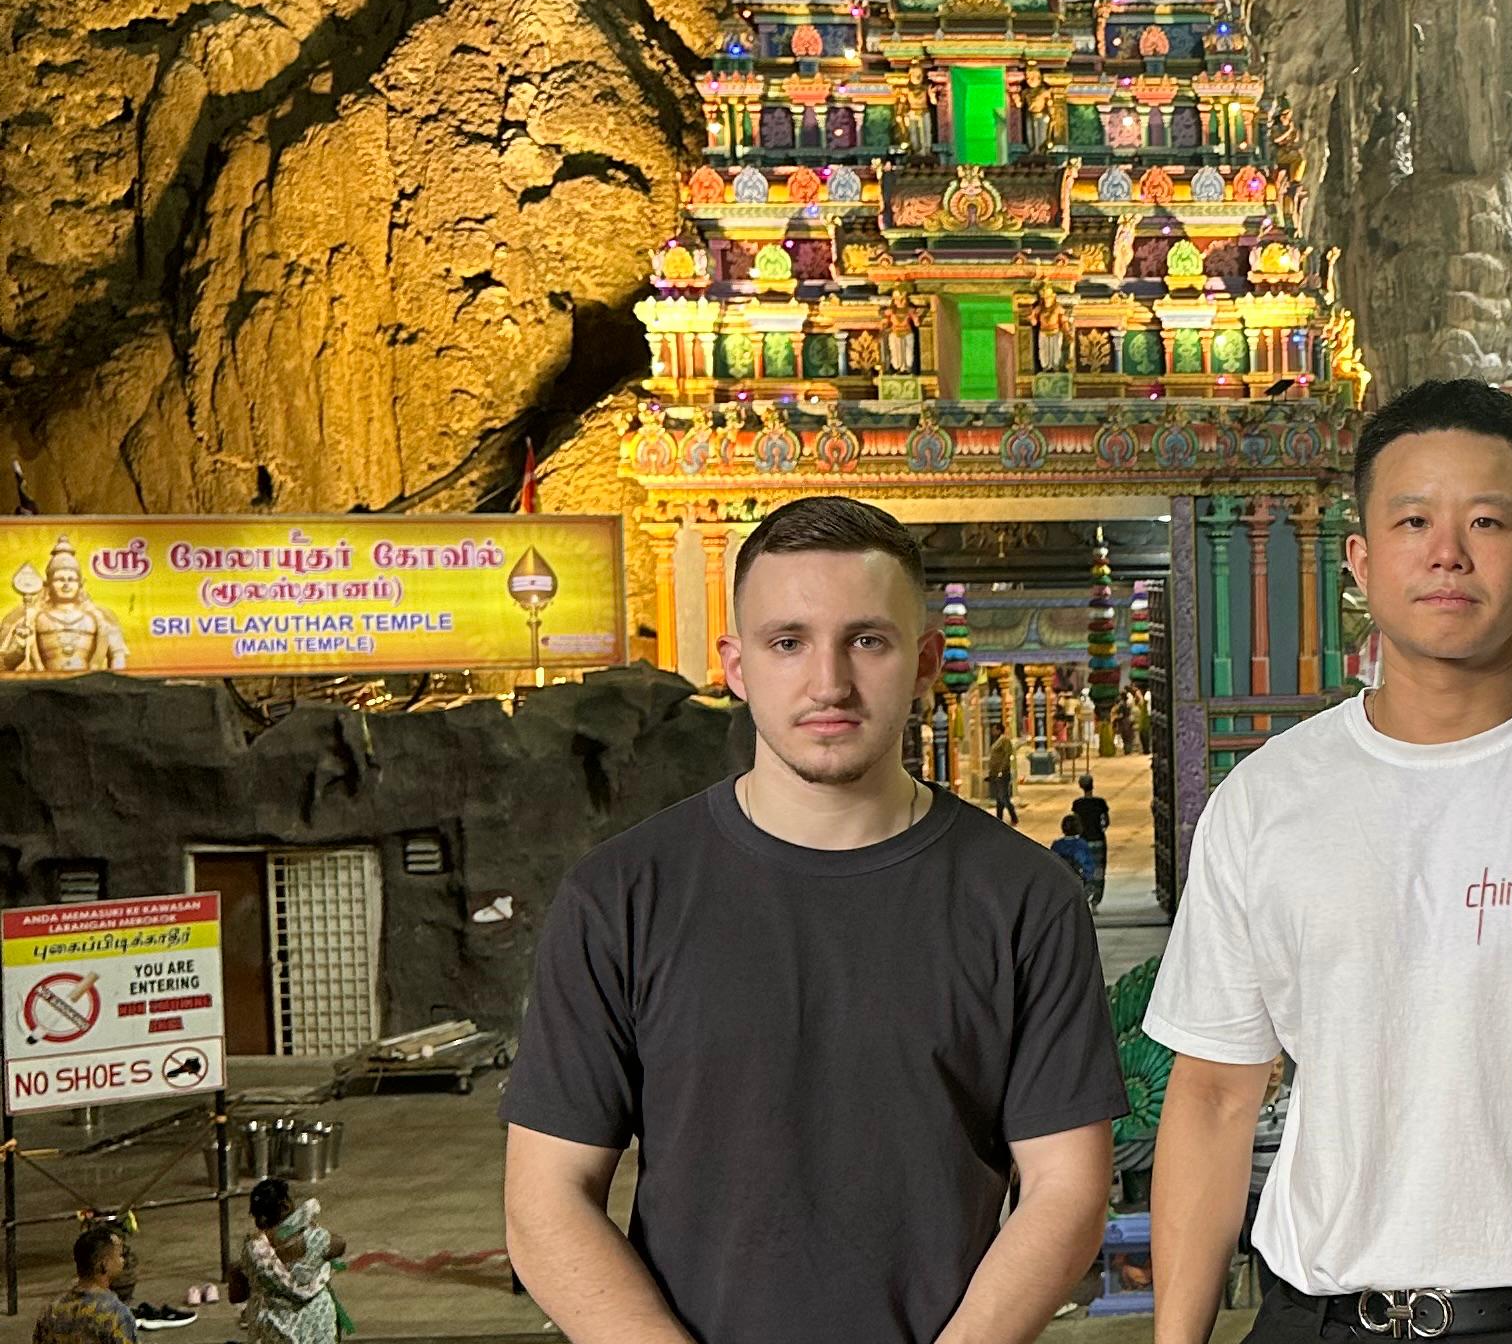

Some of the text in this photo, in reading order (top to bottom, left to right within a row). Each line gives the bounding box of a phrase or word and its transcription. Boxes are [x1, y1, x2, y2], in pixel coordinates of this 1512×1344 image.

[373, 540, 504, 568] கோவில்
[152, 613, 452, 634] SRI VELAYUTHAR TEMPLE
[235, 636, 374, 655] (MAIN TEMPLE)
[22, 911, 59, 926] ANDA
[61, 907, 124, 922] MEMASUKI
[142, 900, 201, 915] KAWASAN
[135, 959, 195, 978] YOU ARE
[130, 975, 200, 995] ENTERING
[15, 1060, 152, 1098] NO SHOES
